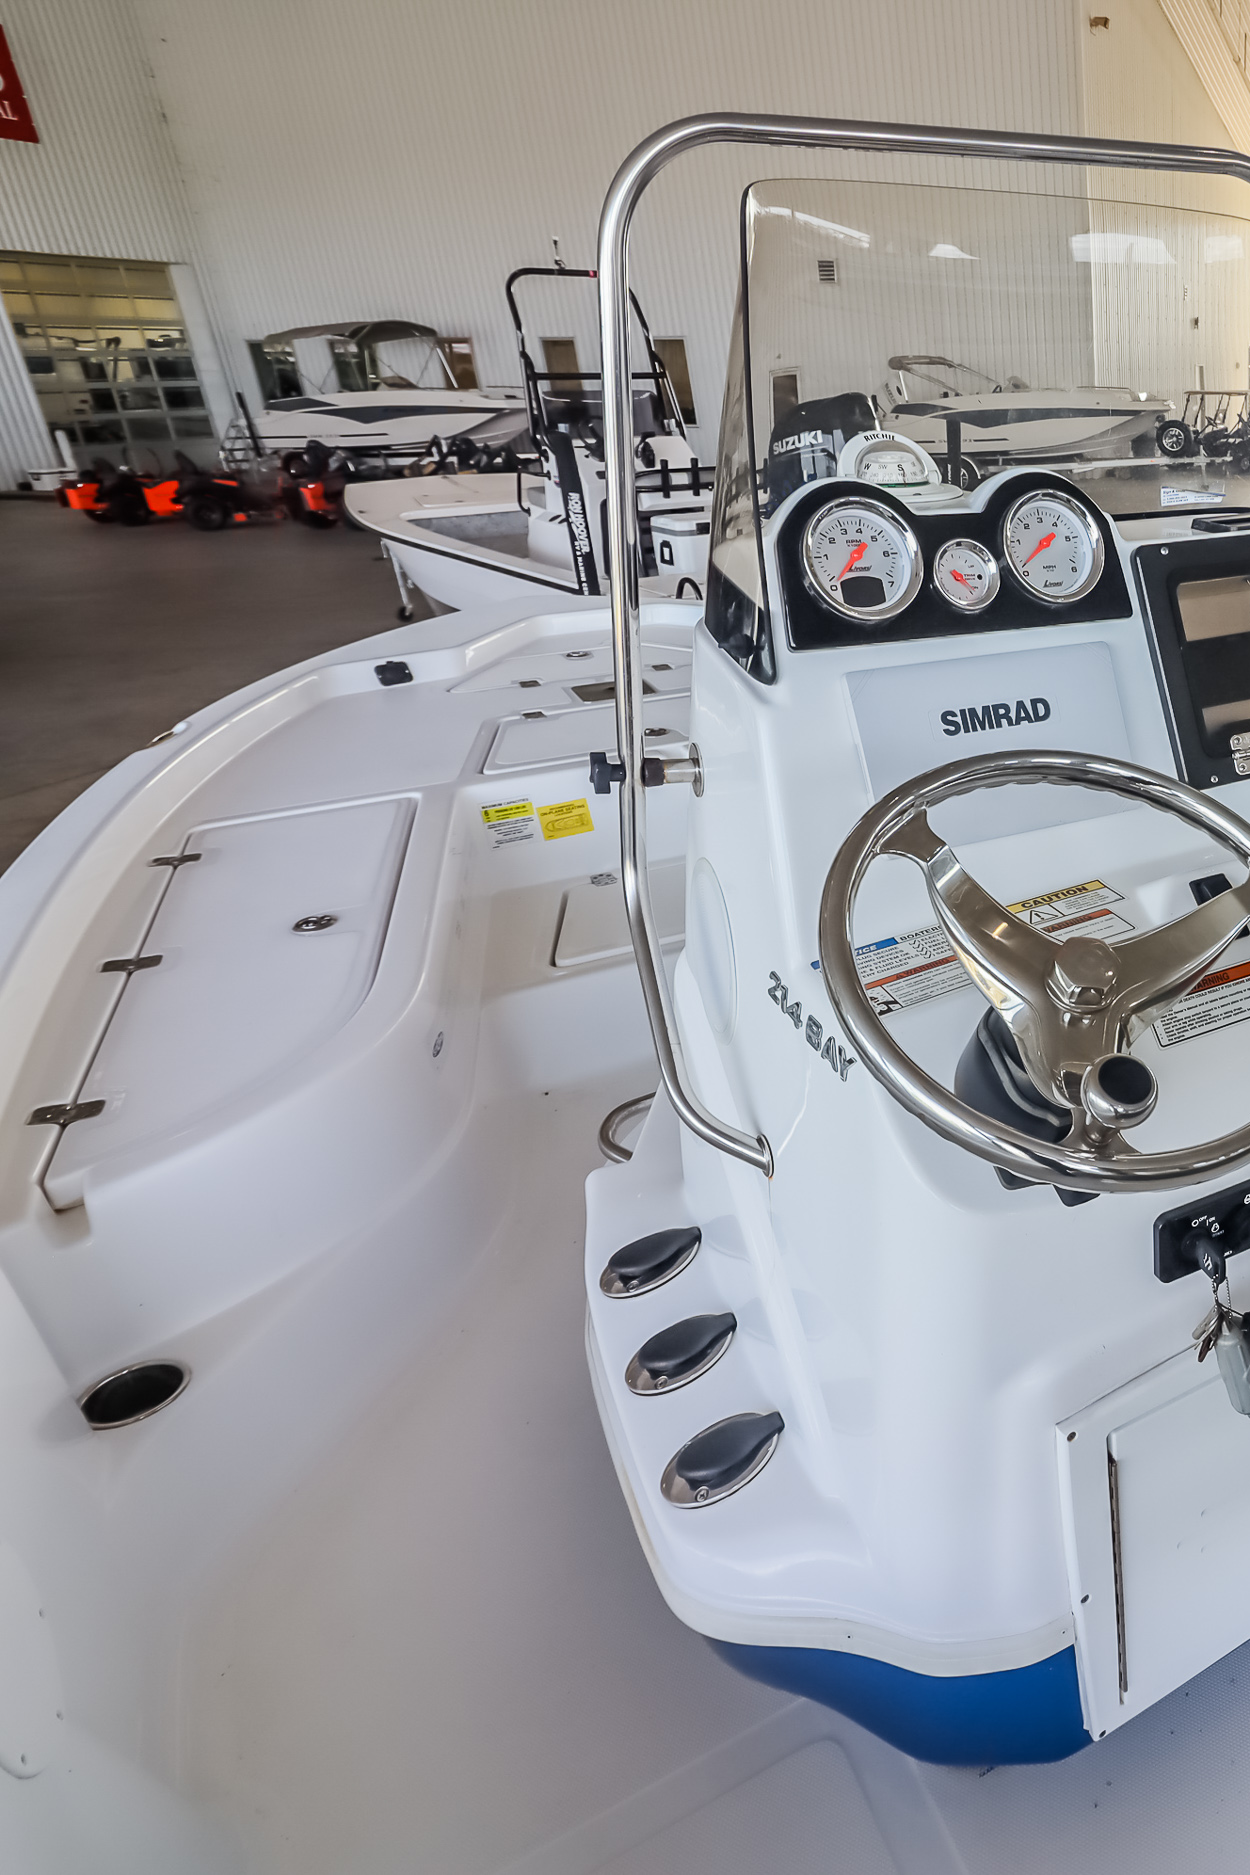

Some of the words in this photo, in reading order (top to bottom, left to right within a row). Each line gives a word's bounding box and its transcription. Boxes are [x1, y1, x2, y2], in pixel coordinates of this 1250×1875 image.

[773, 429, 823, 455] SUZUKI
[863, 433, 895, 442] RITCHIE
[897, 463, 903, 471] S
[567, 492, 583, 514] RON
[575, 514, 590, 554] HOOVER
[940, 697, 1051, 736] SIMRAD
[1020, 885, 1089, 909] CAUTION
[873, 946, 899, 957] SECURE
[876, 949, 905, 961] DEVICES
[873, 955, 899, 966] SYSTEM
[875, 961, 894, 970] FLUID
[894, 954, 920, 964] LEVELS
[877, 961, 909, 974] CHARGED
[1189, 972, 1230, 992] ARNING
[767, 970, 804, 1030] 214
[805, 1013, 857, 1082] BAY
